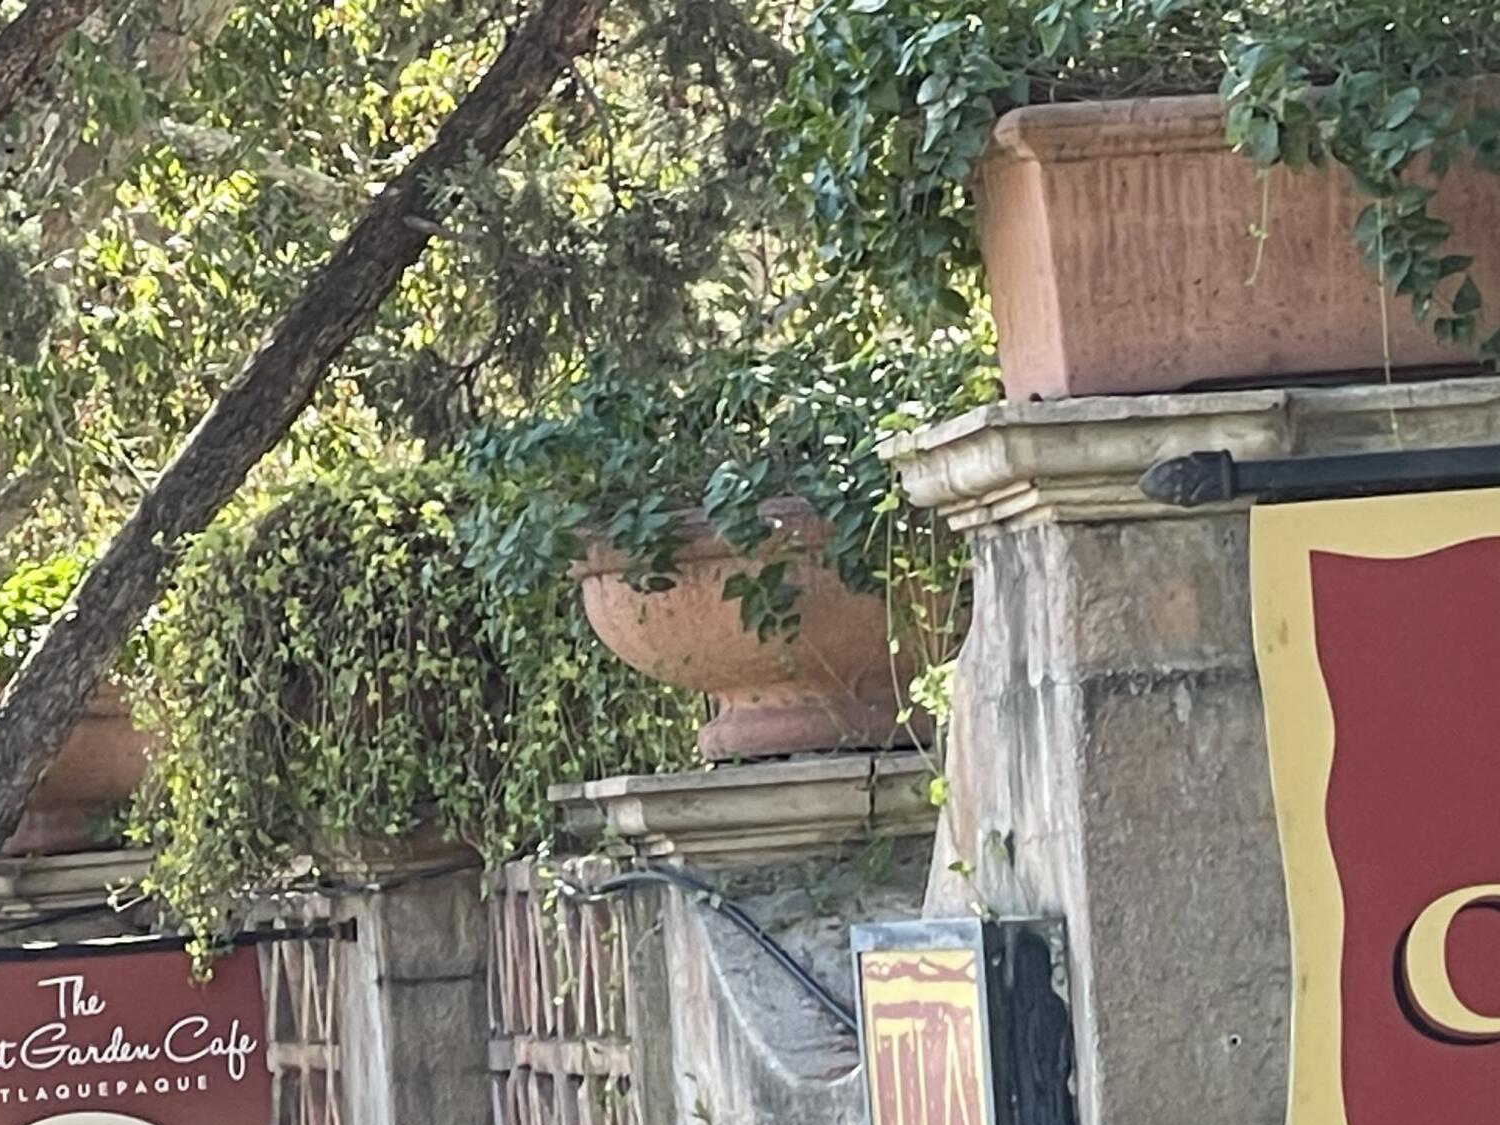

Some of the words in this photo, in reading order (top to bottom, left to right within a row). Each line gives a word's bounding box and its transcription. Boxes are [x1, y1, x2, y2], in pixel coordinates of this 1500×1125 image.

[38, 974, 105, 1019] The
[20, 1022, 160, 1069] Garden
[0, 1074, 208, 1104] TLAQUEPAQUE
